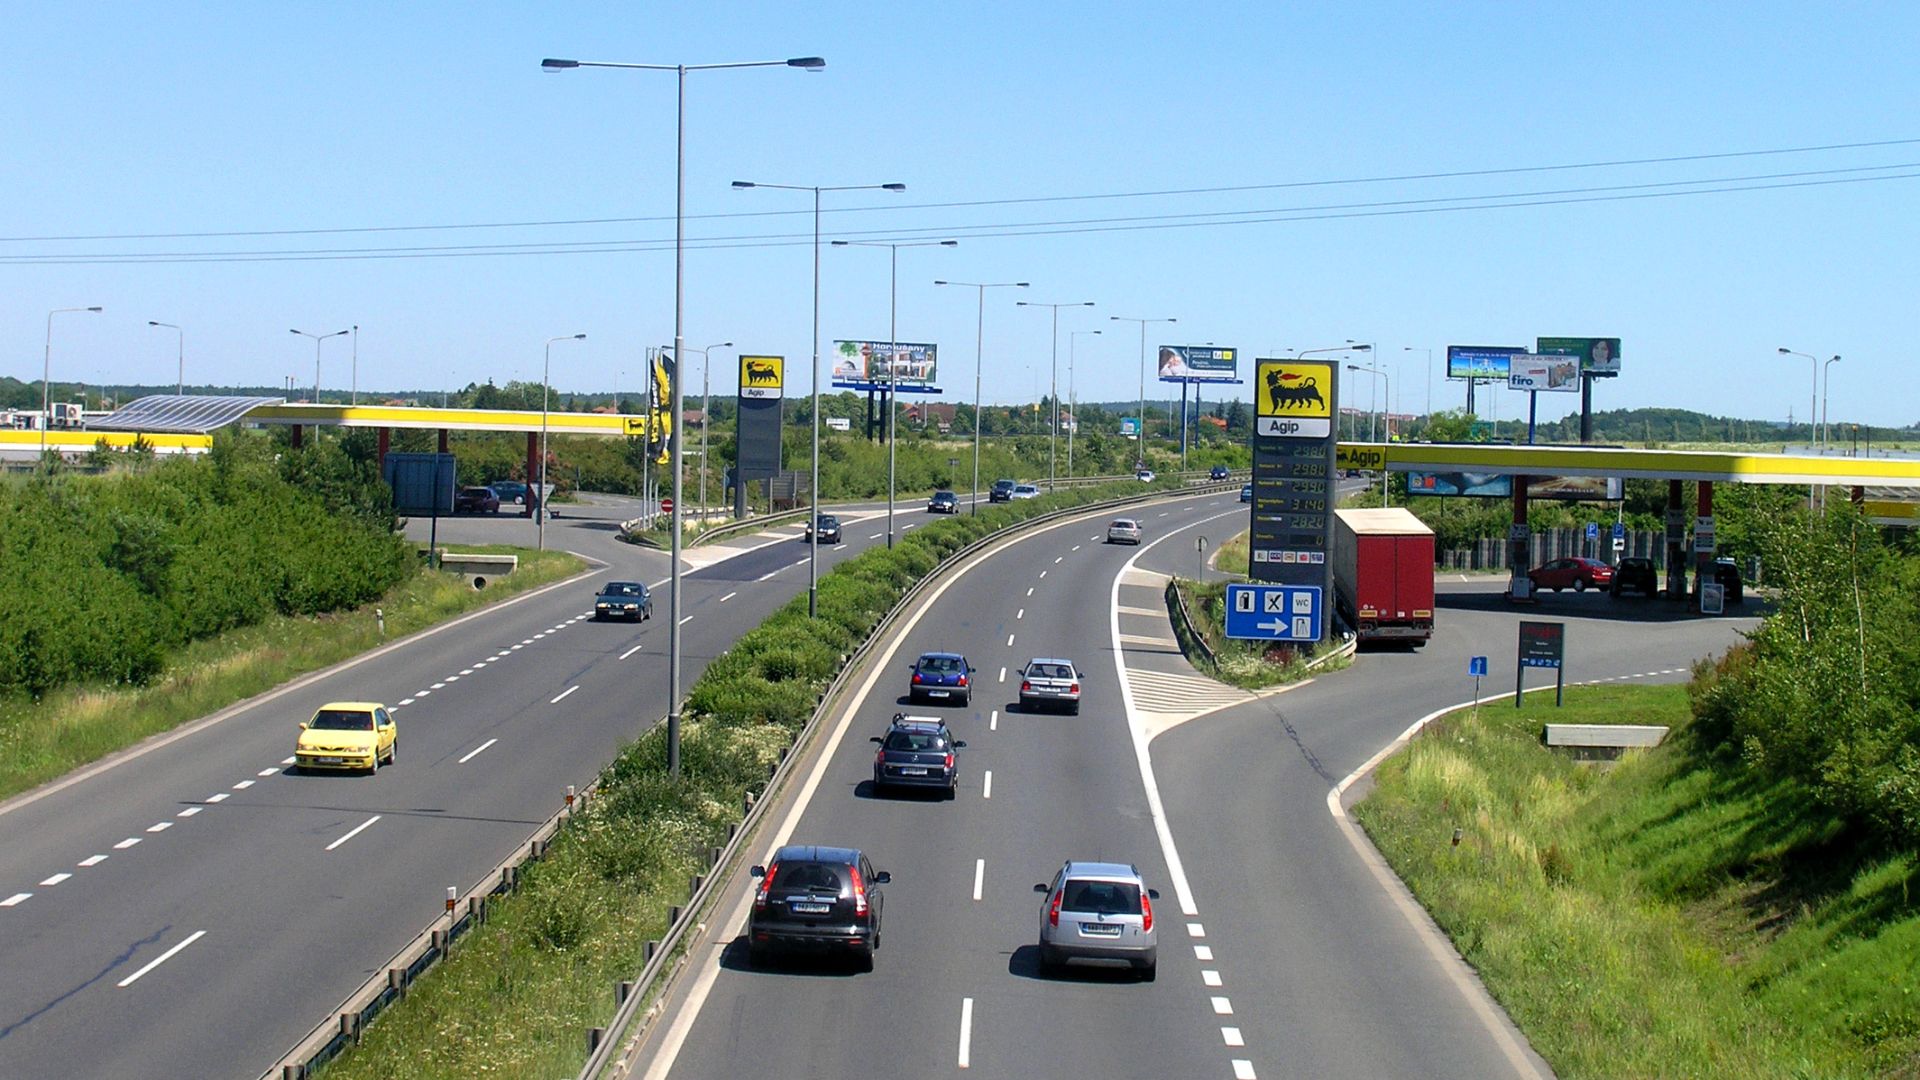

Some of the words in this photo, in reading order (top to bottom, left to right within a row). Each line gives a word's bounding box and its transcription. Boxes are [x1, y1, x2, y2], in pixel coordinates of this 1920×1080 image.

[873, 343, 925, 353] Horušany
[1512, 374, 1533, 385] firo
[748, 389, 764, 397] Agip
[1270, 420, 1299, 434] Agip
[1350, 448, 1380, 467] Agip
[1293, 464, 1326, 476] 2980
[1292, 499, 1325, 511] 3140
[1589, 524, 1595, 533] P
[1295, 599, 1309, 607] WC
